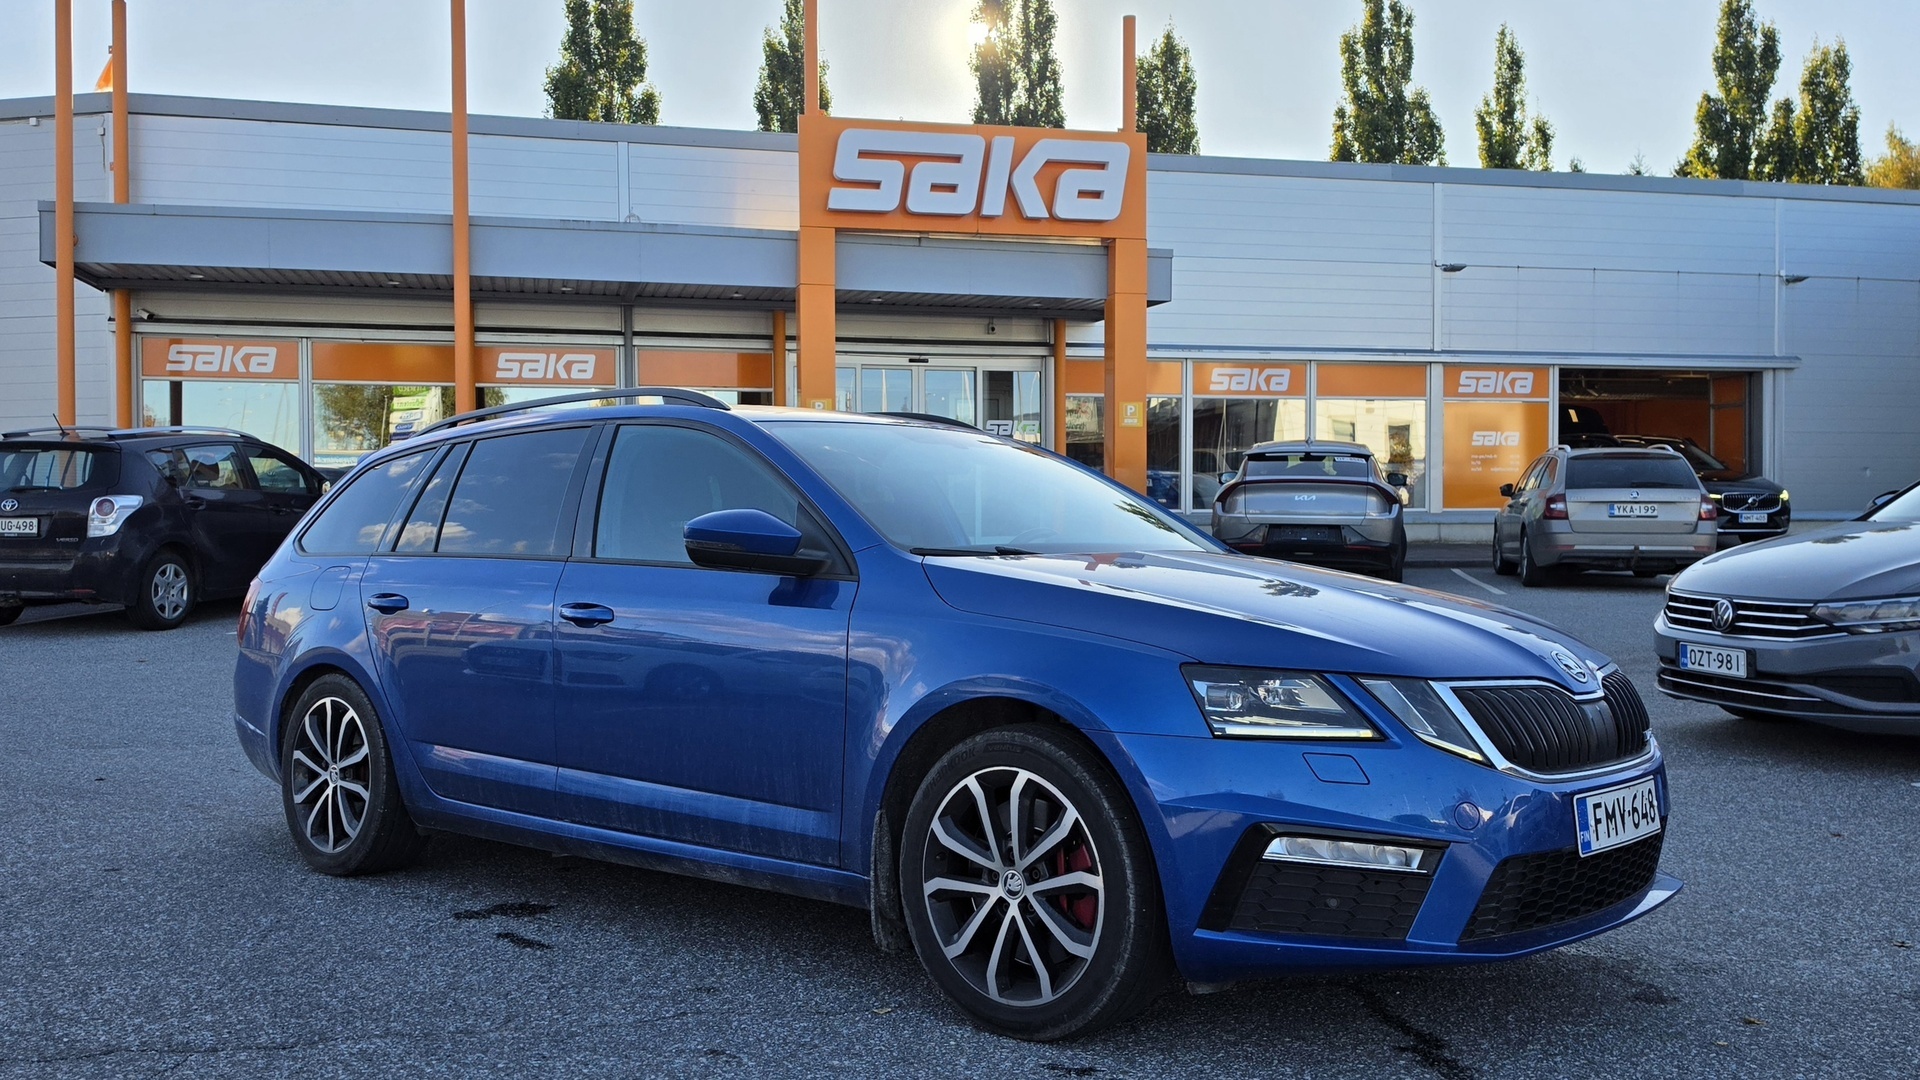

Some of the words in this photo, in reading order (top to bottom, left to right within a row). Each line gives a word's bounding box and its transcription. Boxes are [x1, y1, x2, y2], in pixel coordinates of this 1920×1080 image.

[1127, 405, 1136, 416] P
[1616, 504, 1656, 514] YKA-199
[1689, 648, 1740, 673] OZT-981
[1592, 787, 1656, 842] FMV-648
